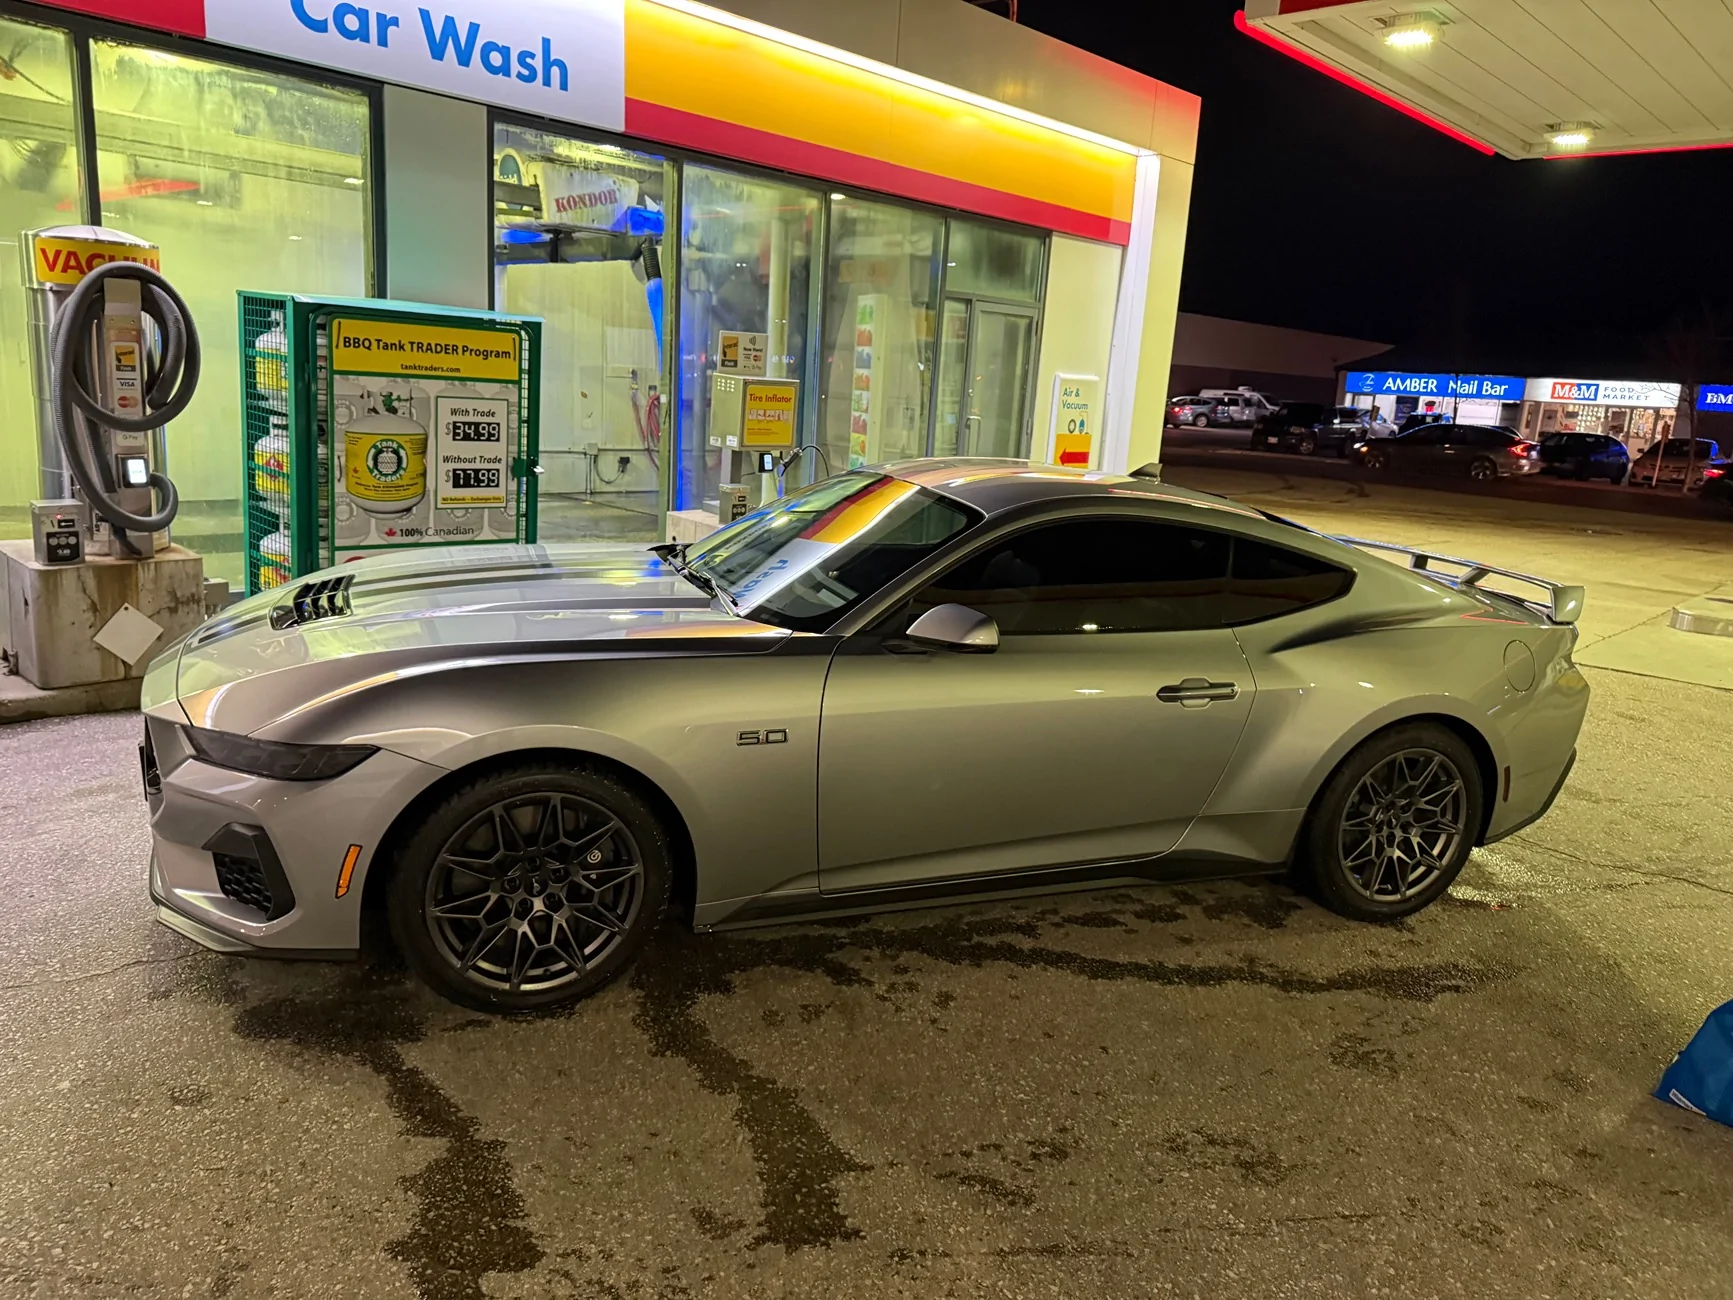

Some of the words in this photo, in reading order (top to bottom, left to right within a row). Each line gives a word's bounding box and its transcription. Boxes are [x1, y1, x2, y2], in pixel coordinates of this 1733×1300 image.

[290, 0, 399, 48] Car
[418, 7, 569, 92] Wash
[554, 188, 618, 213] KONDOR
[343, 336, 372, 350] BBQ
[375, 338, 406, 352] Tank
[408, 341, 459, 356] TRADER
[462, 345, 511, 360] Program
[400, 363, 461, 374] tanktraders.com
[1062, 387, 1073, 397] Air
[1074, 388, 1080, 397] &
[1382, 377, 1438, 392] AMBER
[1447, 379, 1478, 395] Nail
[1481, 381, 1508, 396] Bar
[1553, 383, 1597, 399] M&M
[749, 394, 763, 403] Tire
[765, 394, 792, 403] Inflator
[1062, 400, 1088, 410] Vacuum
[450, 408, 470, 417] With
[472, 409, 496, 418] Trade
[375, 440, 399, 449] Tank
[442, 455, 477, 464] Without
[479, 455, 502, 464] Trade
[371, 470, 405, 482] Traders
[400, 528, 423, 538] 100%
[425, 526, 474, 537] Canadian
